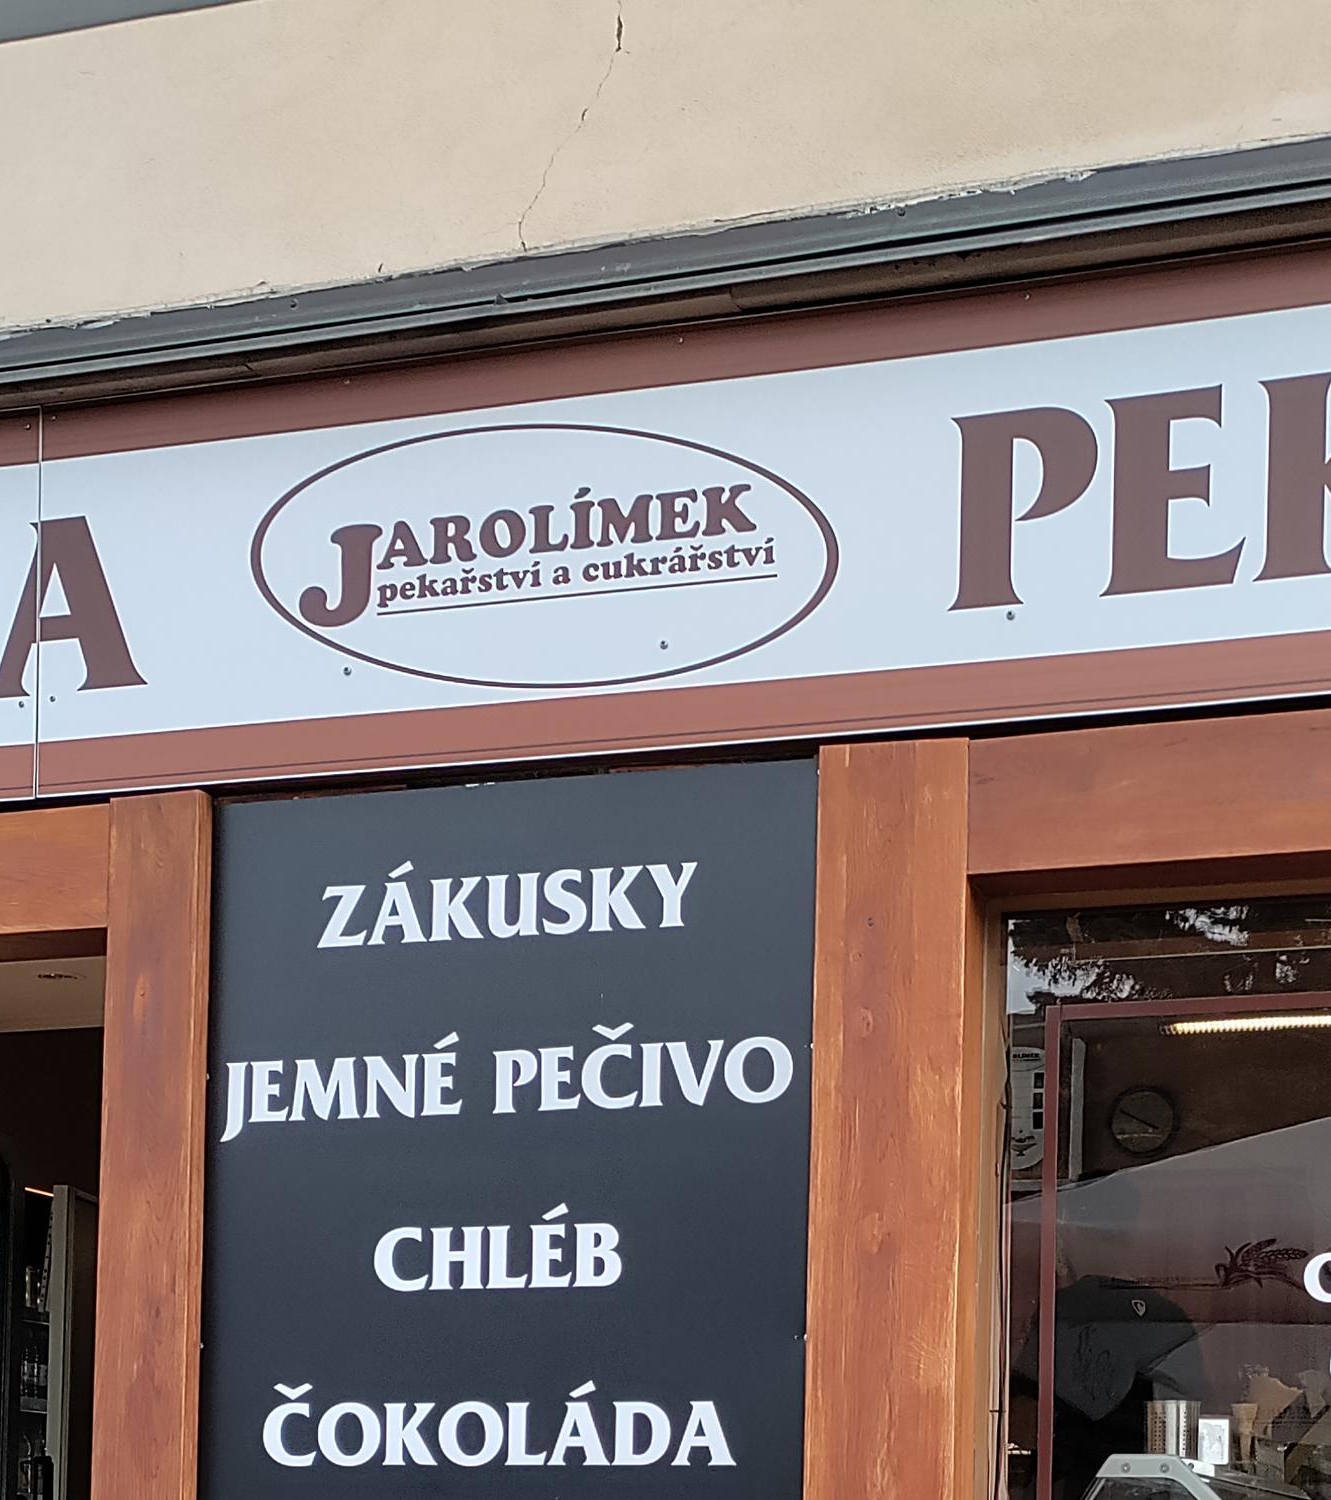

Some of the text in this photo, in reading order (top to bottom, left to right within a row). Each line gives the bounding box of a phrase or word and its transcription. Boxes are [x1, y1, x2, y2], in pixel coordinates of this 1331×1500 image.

[299, 486, 756, 628] JAROLÍMEK
[377, 537, 776, 608] pekařství a cukrářství
[317, 861, 697, 948] ZÁKUSKY
[220, 1022, 793, 1142] JEMNÉ PEČIVO
[373, 1203, 622, 1292] CHLÉB
[263, 1380, 737, 1466] ČOKOLÁDA
